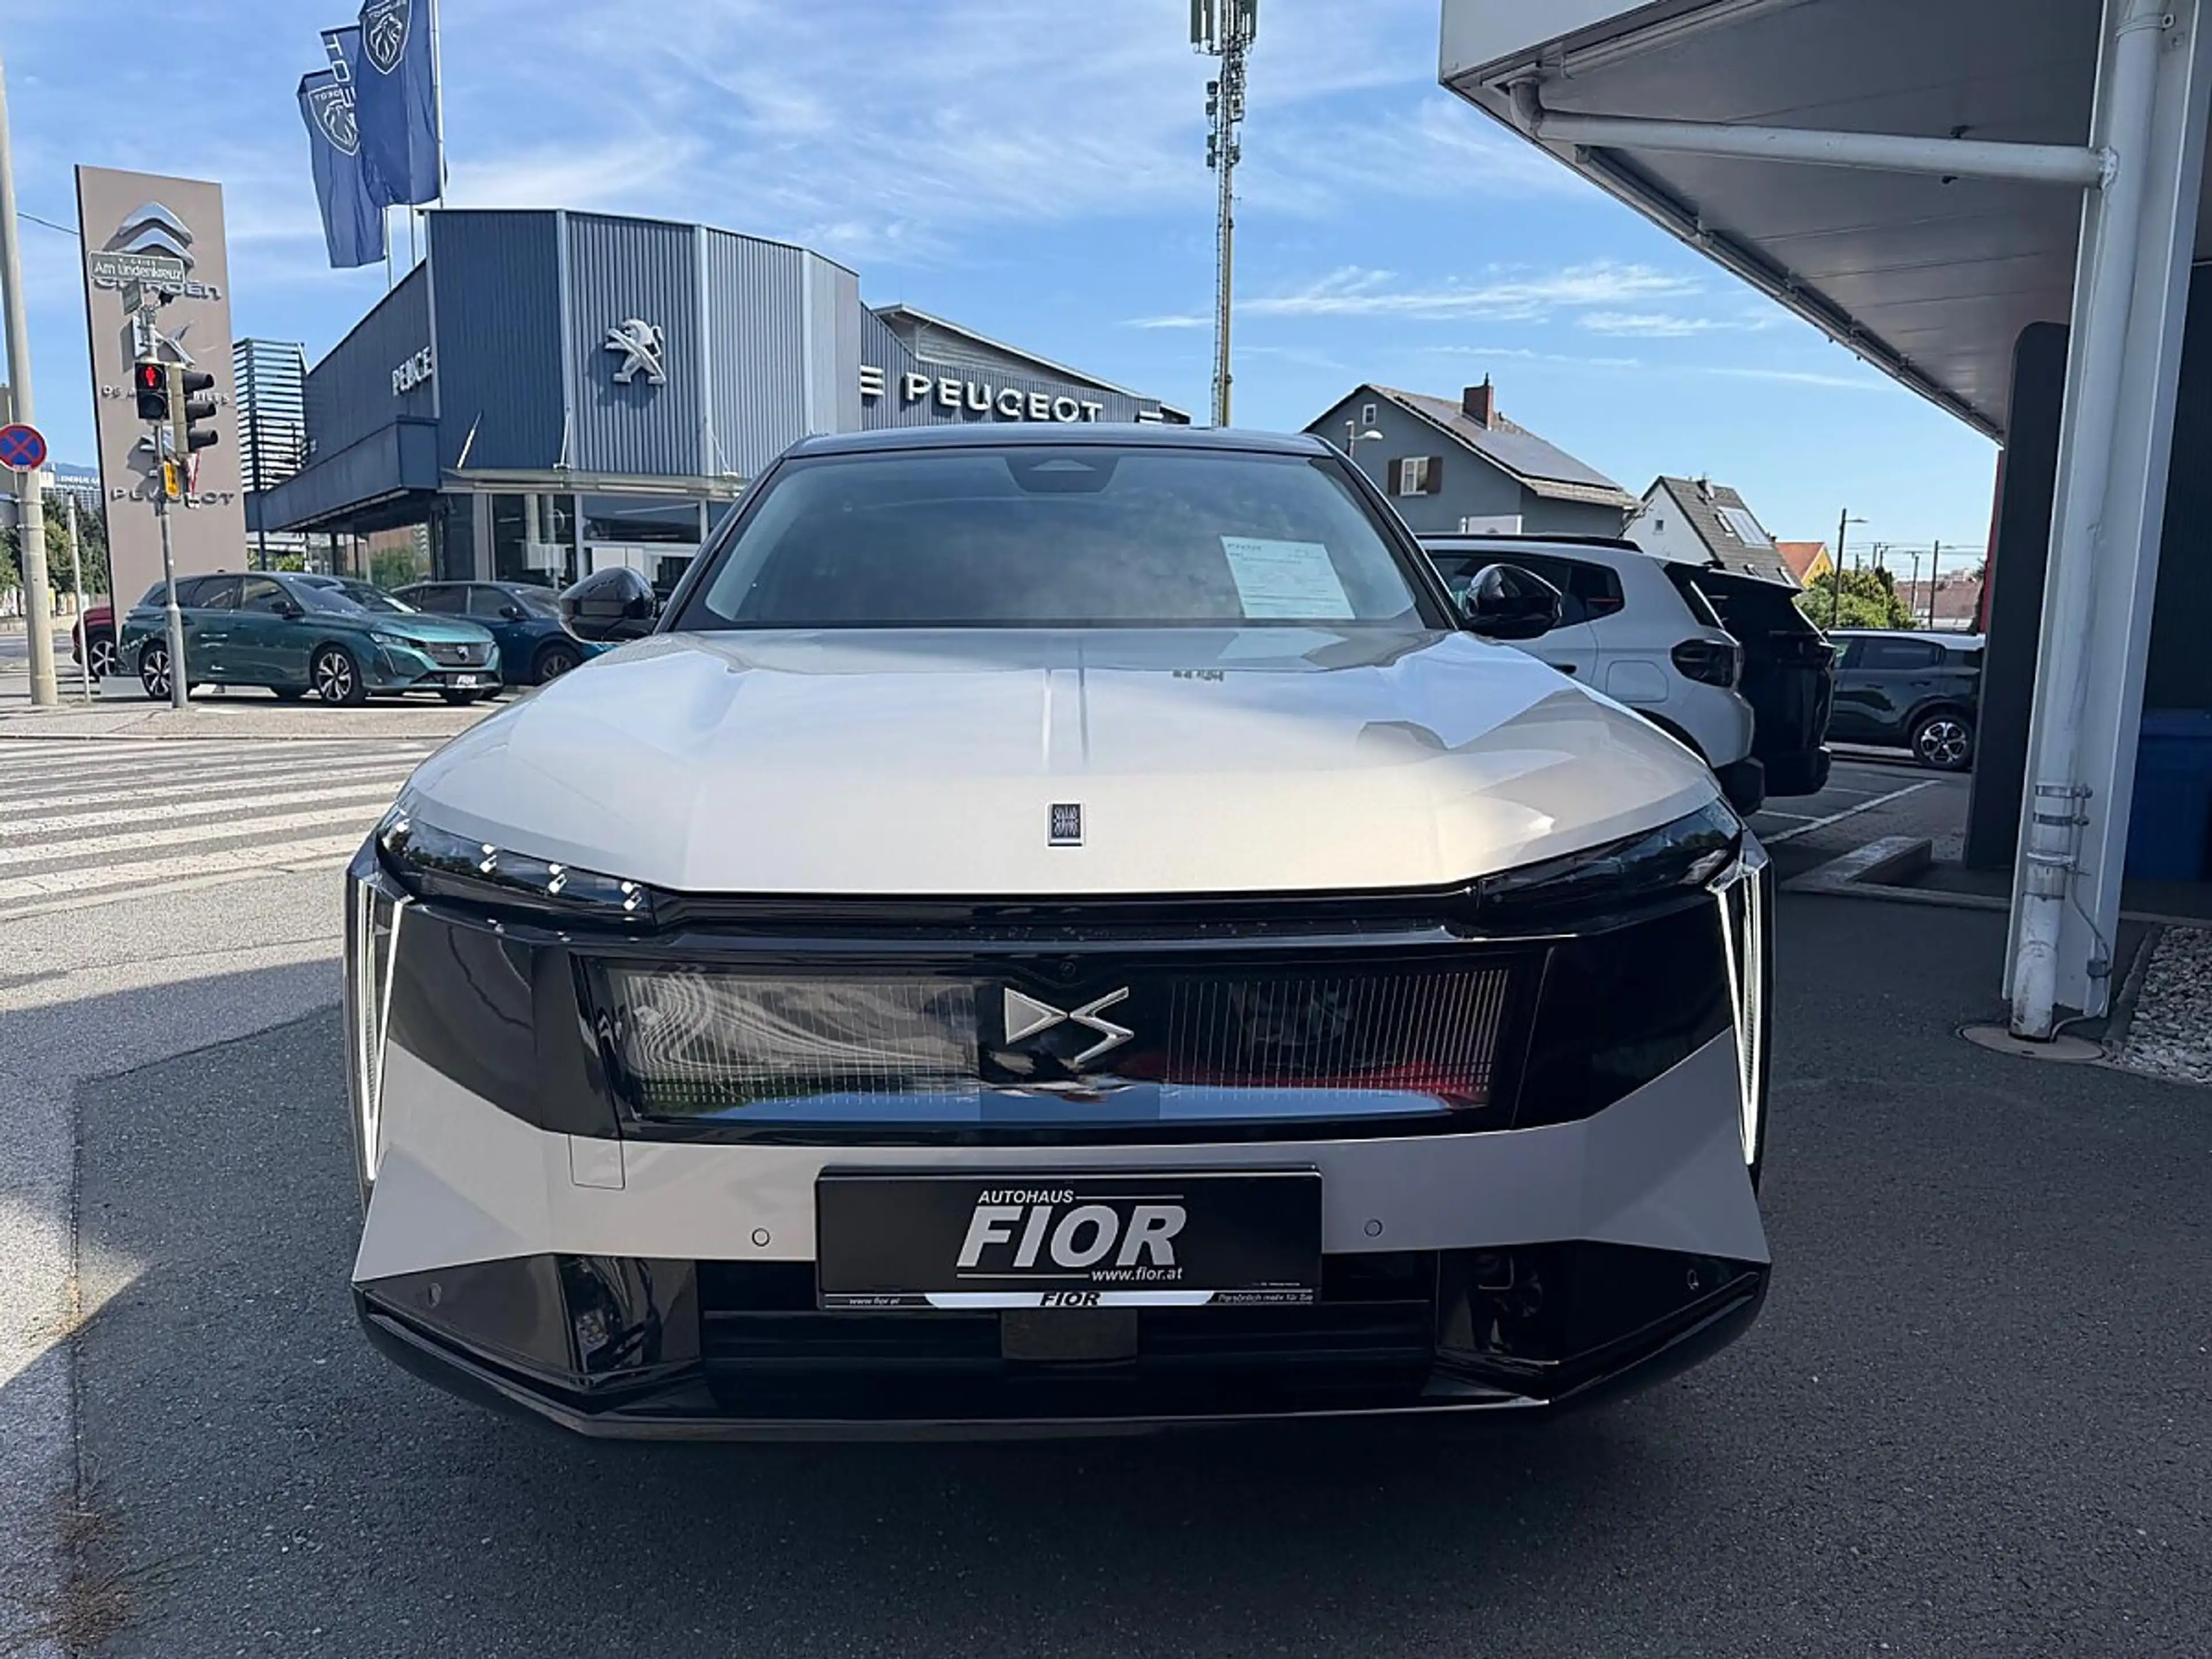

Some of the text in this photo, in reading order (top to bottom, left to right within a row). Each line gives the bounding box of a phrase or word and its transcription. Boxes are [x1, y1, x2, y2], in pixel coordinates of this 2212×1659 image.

[94, 261, 116, 275] Am
[905, 372, 1104, 423] PEUGEOT
[978, 1190, 1074, 1204] AUTOHAUS
[957, 1205, 1187, 1267] FIOR
[1092, 1267, 1183, 1282] www.fior.at
[1039, 1292, 1101, 1306] FIOR
